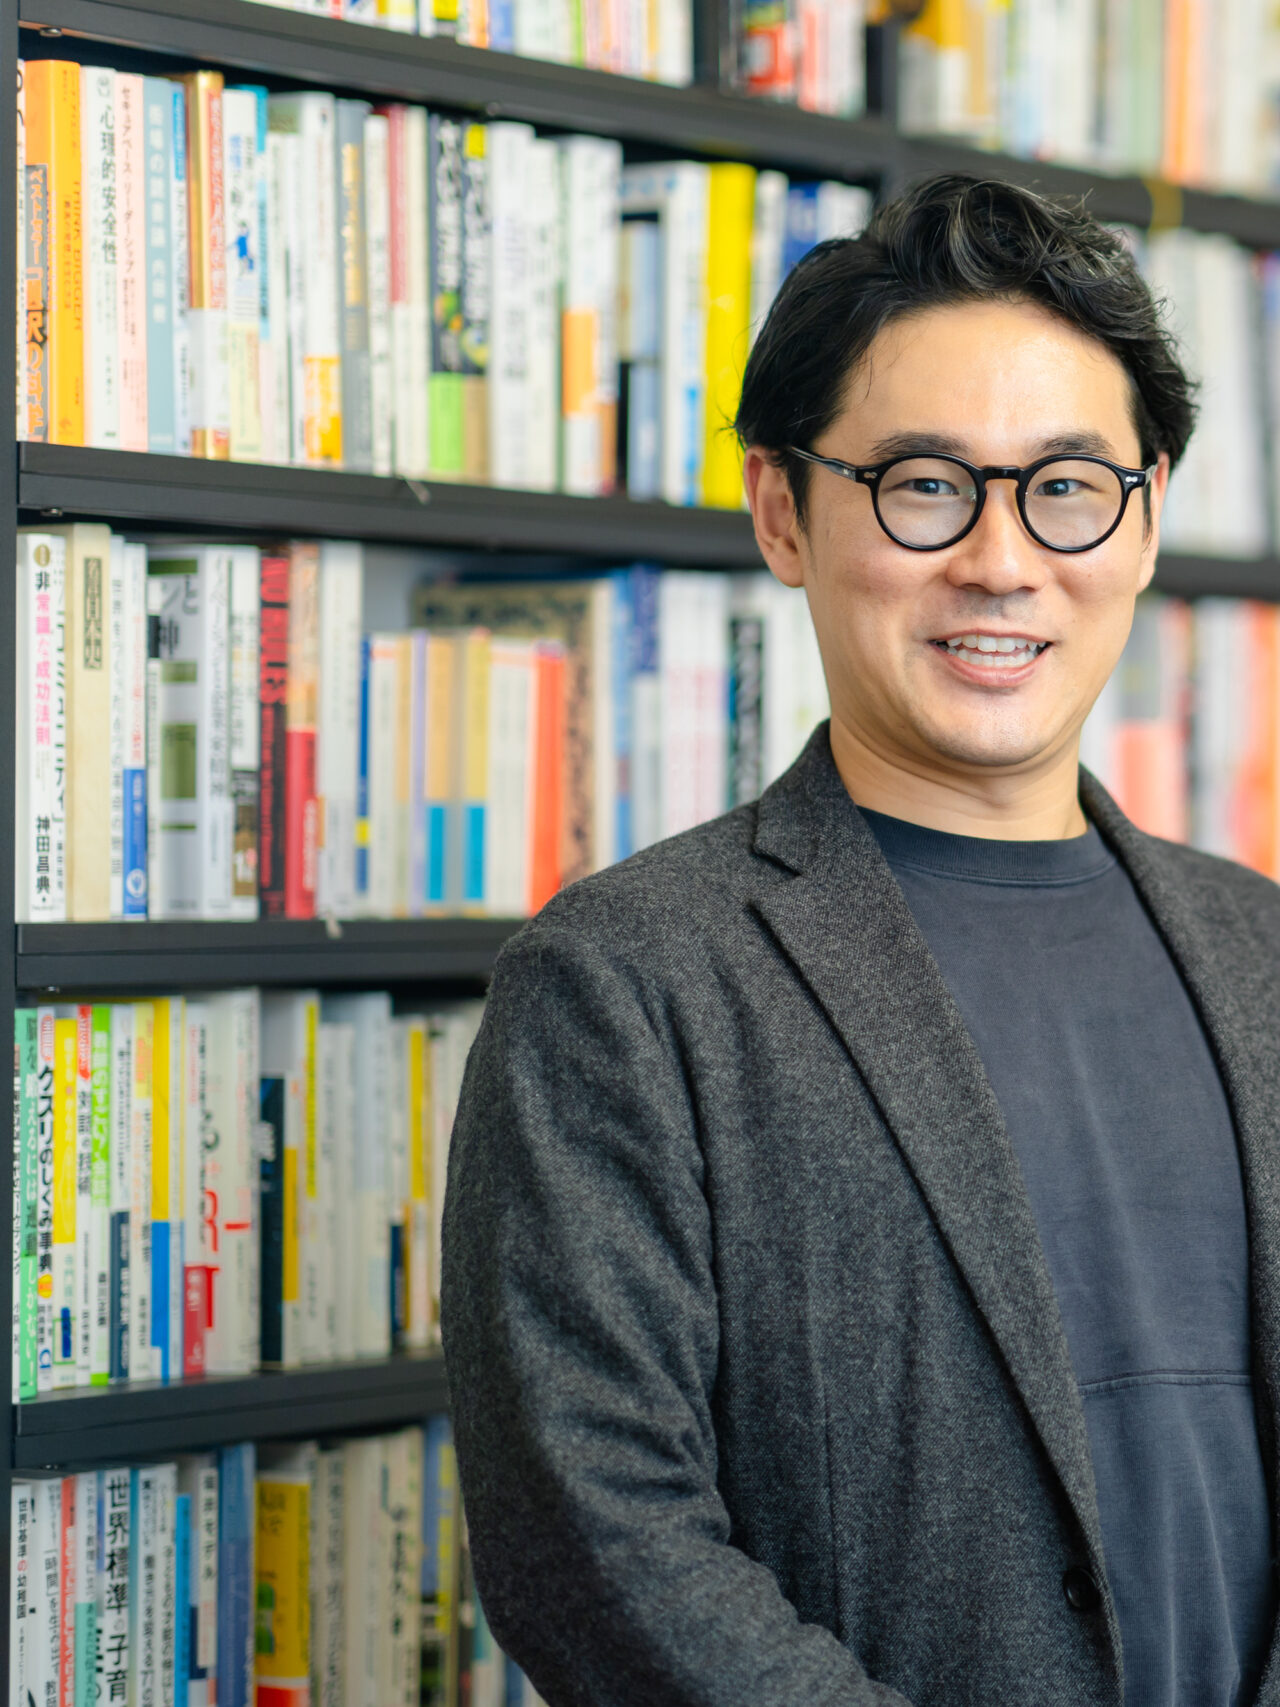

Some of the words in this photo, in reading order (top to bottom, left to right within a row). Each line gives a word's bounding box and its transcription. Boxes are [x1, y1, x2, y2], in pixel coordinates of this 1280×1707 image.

[100, 104, 118, 264] 心理的安全性
[35, 570, 51, 746] 非常識な成功法則
[35, 813, 51, 895] 神田昌典
[105, 1476, 129, 1707] 世界標準の子育
